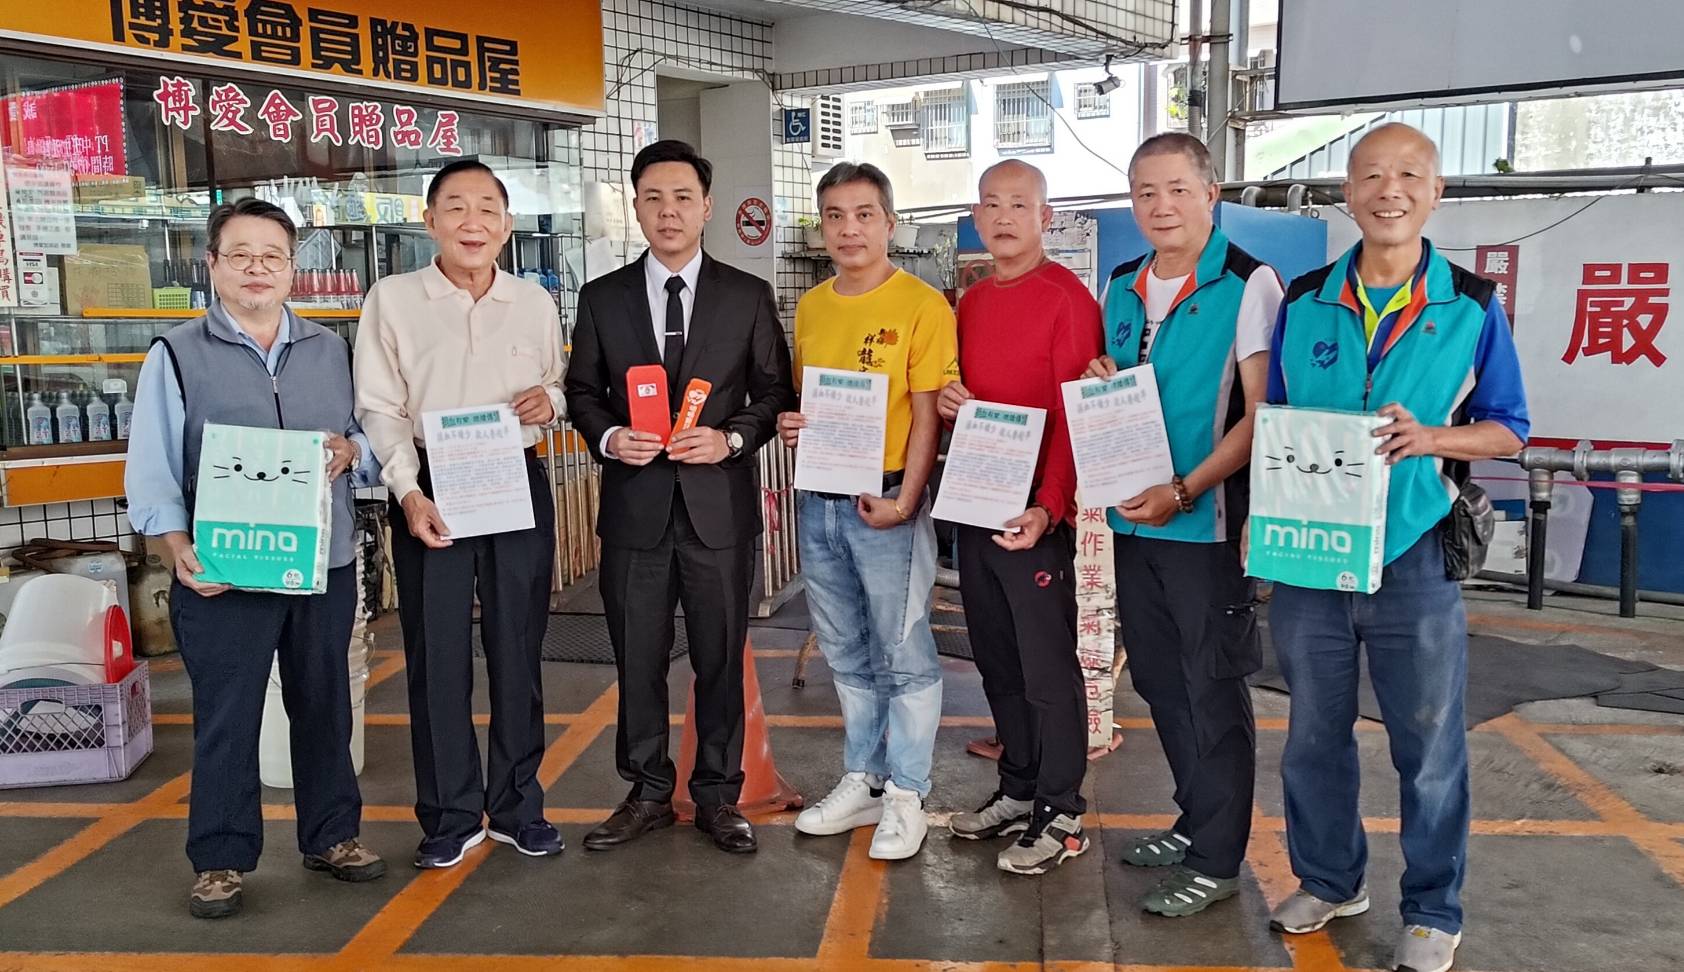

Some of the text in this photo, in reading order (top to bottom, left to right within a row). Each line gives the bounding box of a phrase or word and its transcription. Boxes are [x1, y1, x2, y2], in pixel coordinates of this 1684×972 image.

[111, 0, 522, 96] 博愛會員贈品屋
[153, 75, 464, 156] 博愛會員贈品屋
[1561, 263, 1670, 368] 嚴
[211, 522, 298, 553] mina
[1263, 519, 1353, 554] mina
